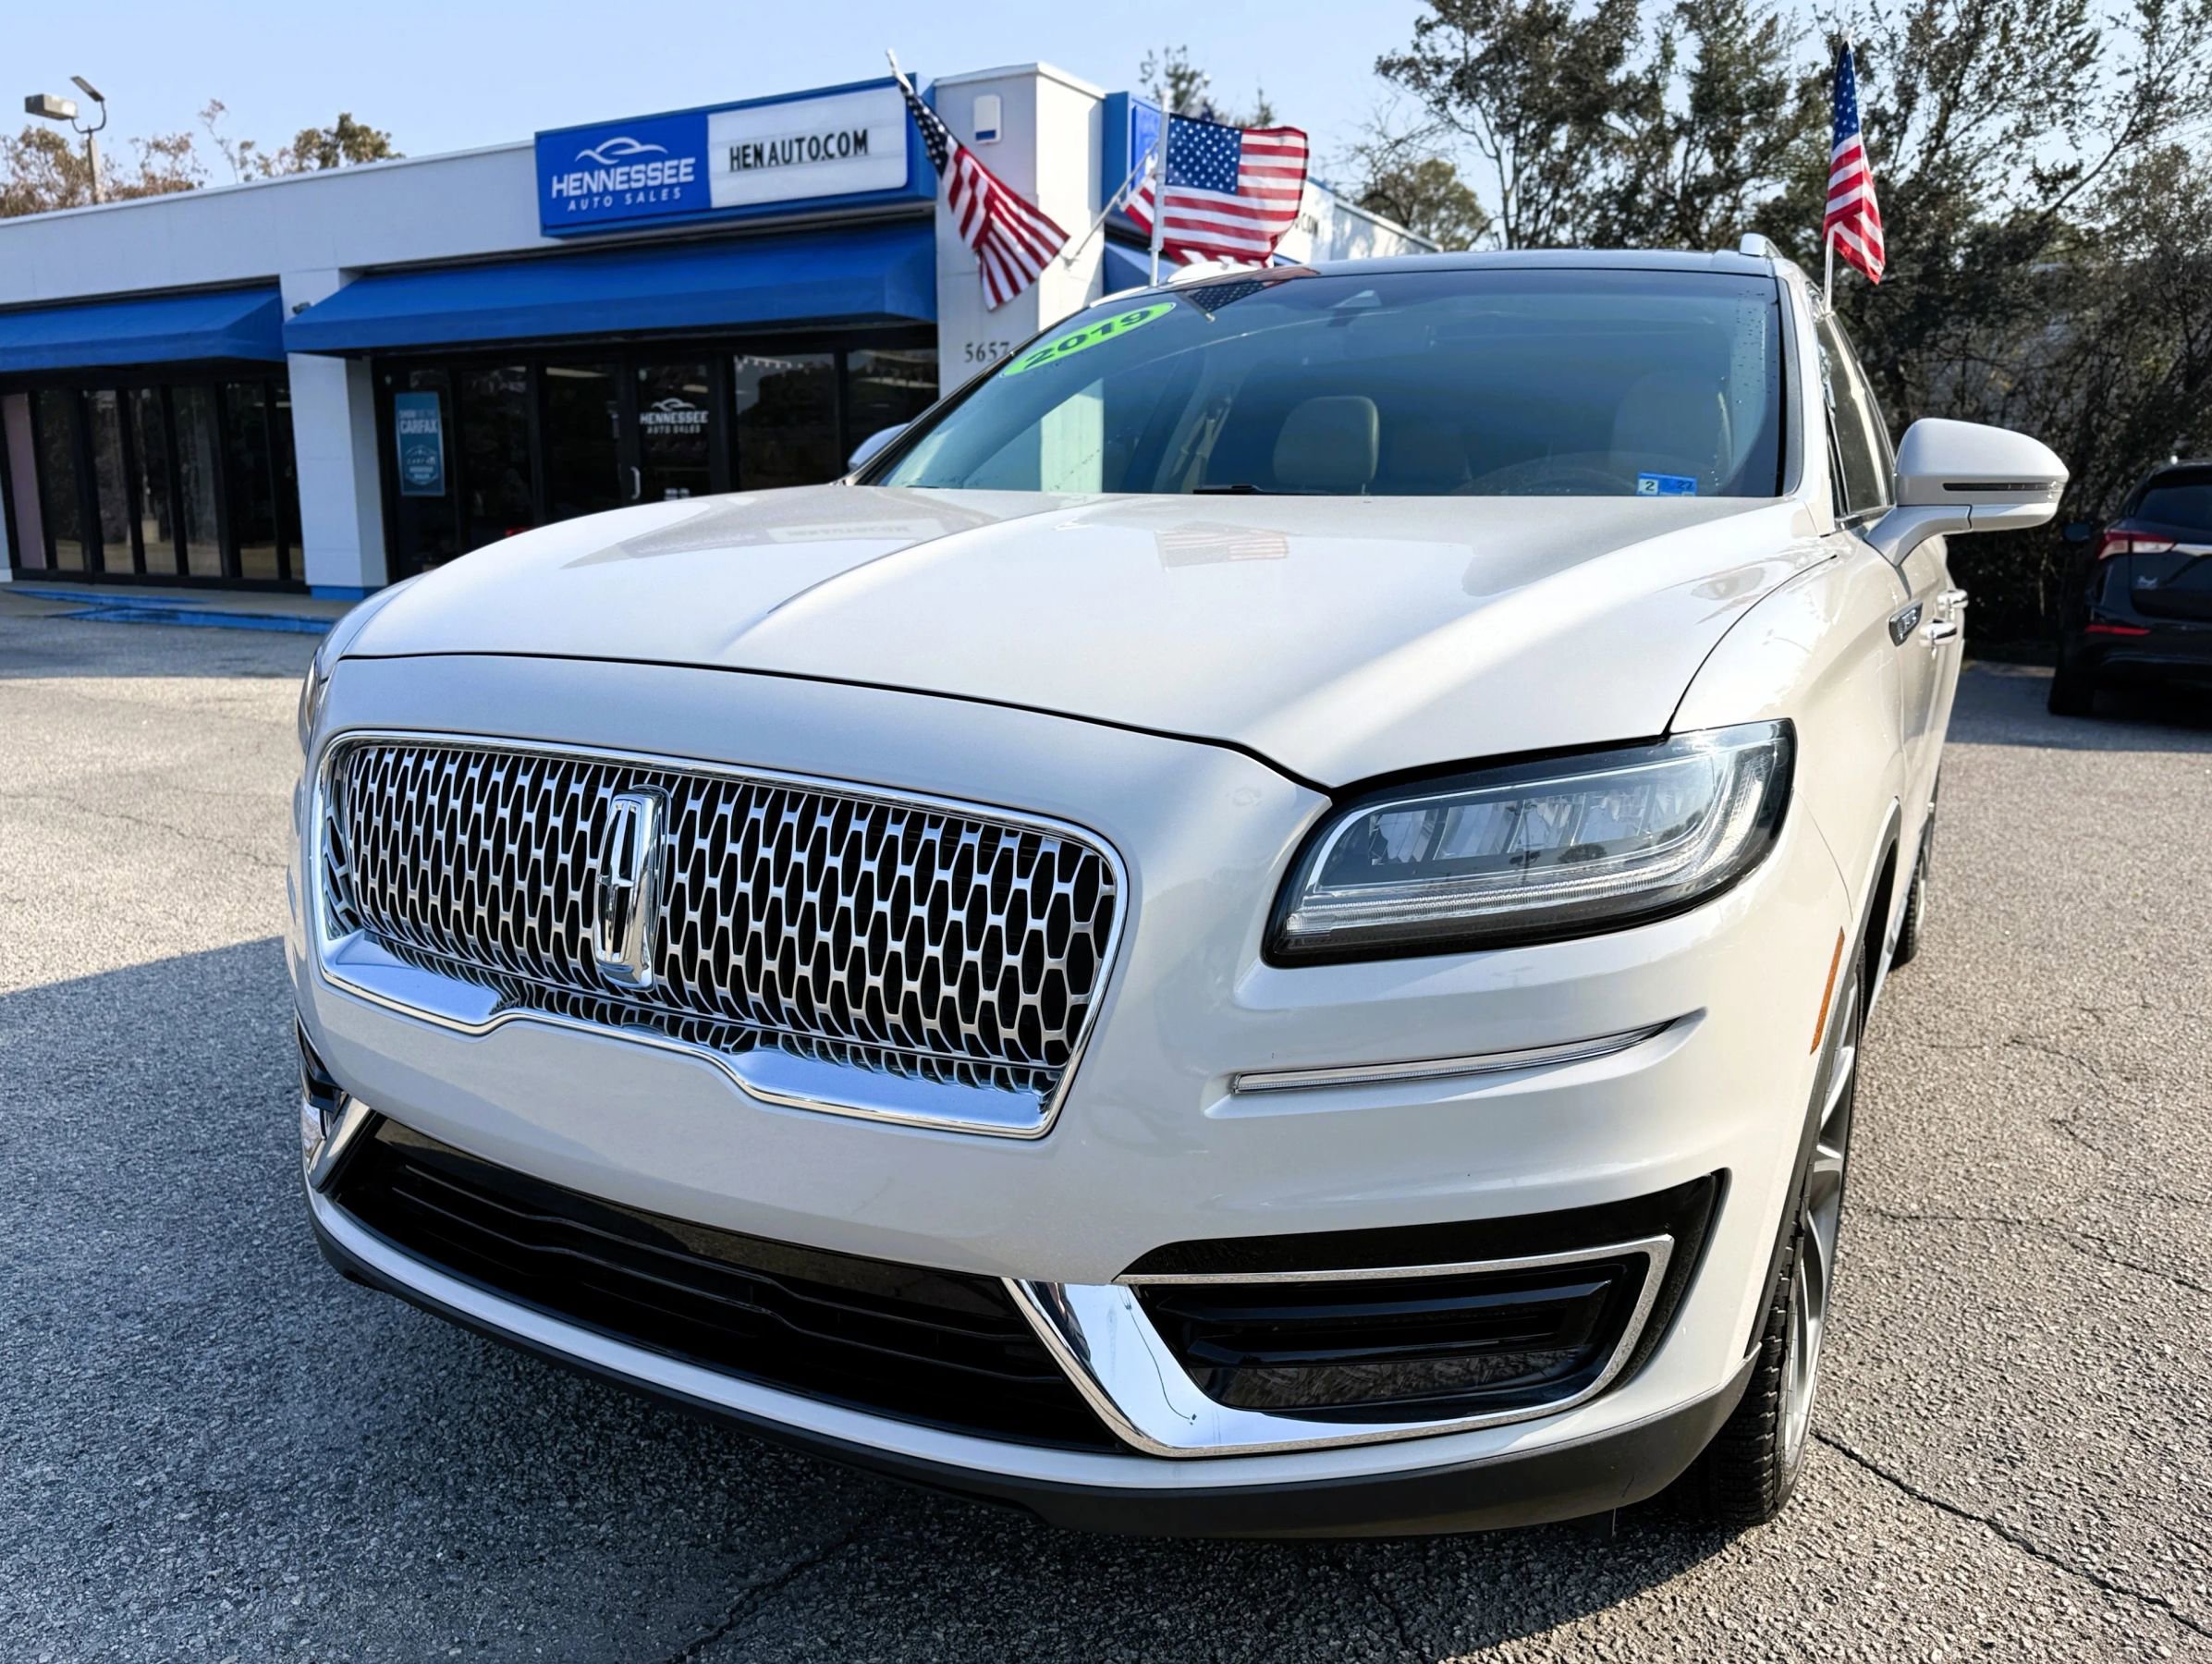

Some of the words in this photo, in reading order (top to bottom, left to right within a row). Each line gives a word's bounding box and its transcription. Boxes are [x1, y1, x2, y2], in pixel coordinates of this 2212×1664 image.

[729, 128, 868, 172] HENAUTO.COM
[551, 157, 696, 199] HENNESSEE
[568, 195, 614, 212] AUTO
[624, 187, 681, 205] SALES
[965, 341, 1009, 362] 5657
[1024, 310, 1153, 370] 2019
[400, 419, 439, 434] CARFAX
[640, 410, 709, 424] HENNESSEE
[1645, 481, 1655, 491] 2
